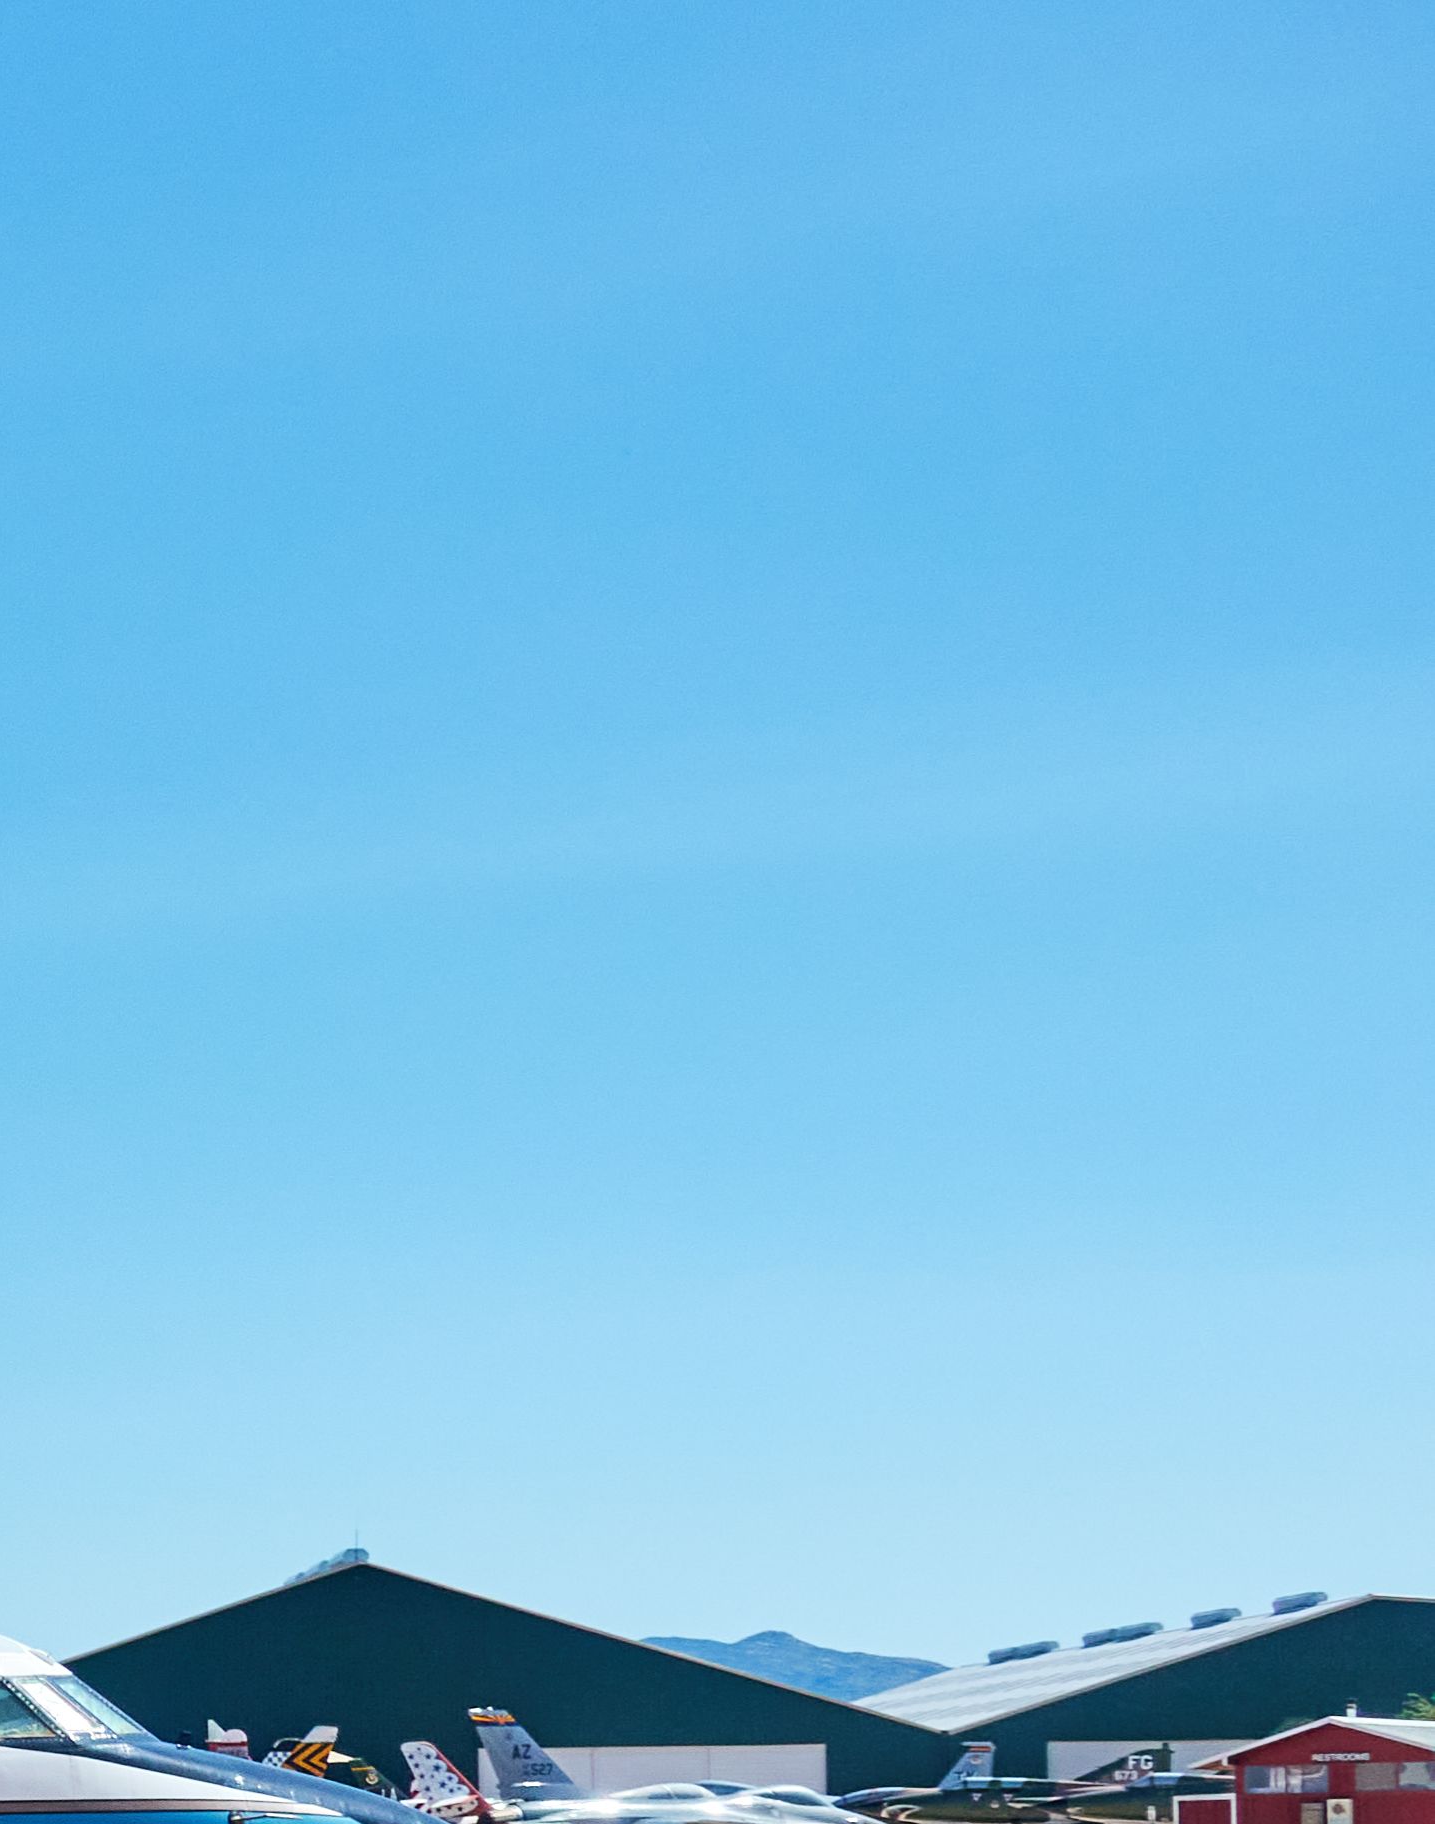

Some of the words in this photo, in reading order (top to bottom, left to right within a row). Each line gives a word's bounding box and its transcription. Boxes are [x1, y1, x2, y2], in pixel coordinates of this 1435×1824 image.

[512, 1744, 532, 1759] AZ
[1311, 1753, 1370, 1761] RESTROOMS
[1128, 1755, 1153, 1769] FG
[531, 1763, 553, 1776] 527
